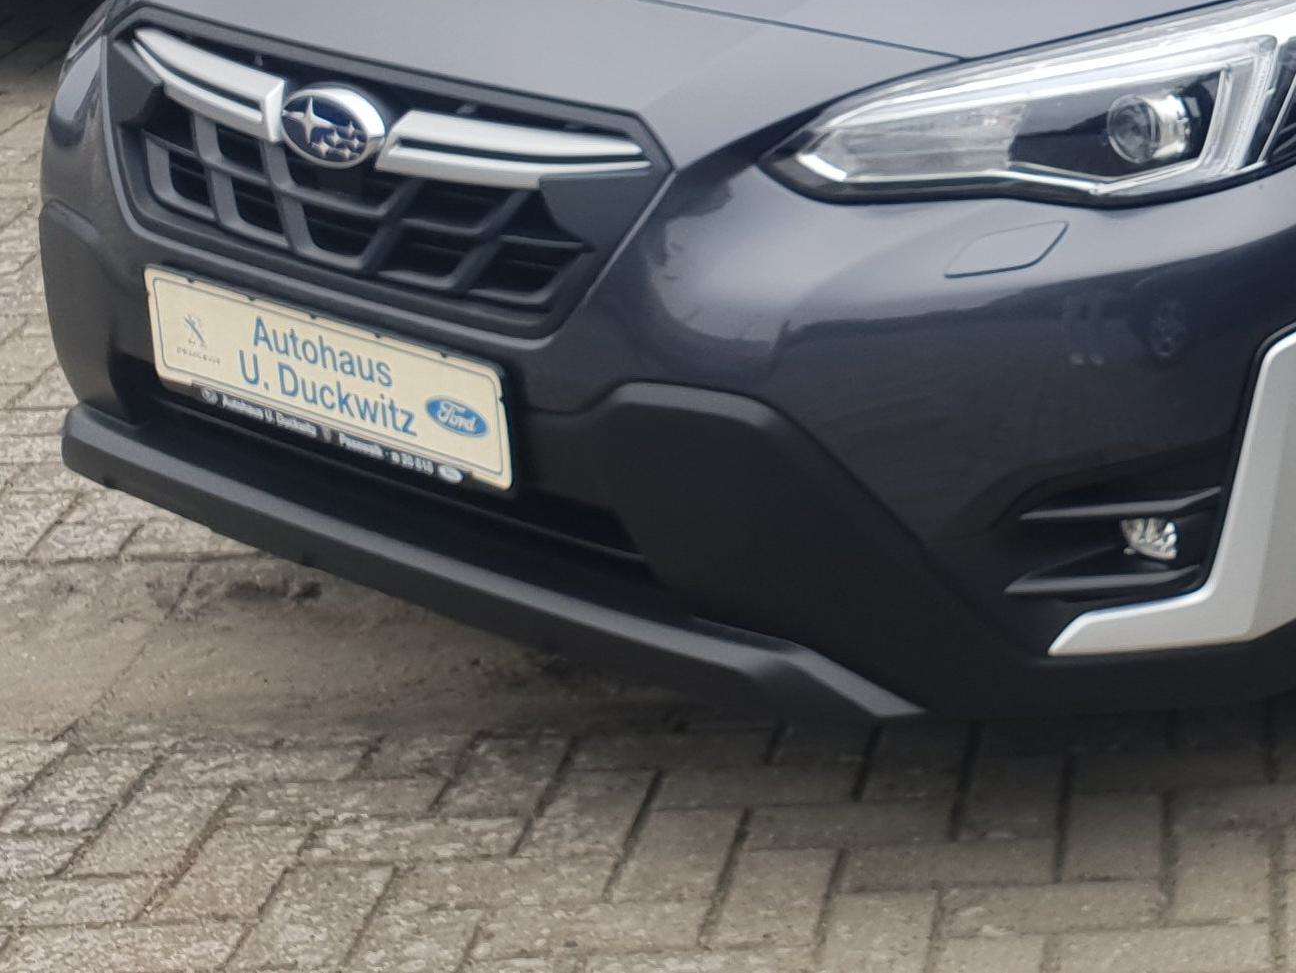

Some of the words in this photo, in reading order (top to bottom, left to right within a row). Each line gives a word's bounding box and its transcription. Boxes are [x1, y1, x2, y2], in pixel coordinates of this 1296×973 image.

[253, 316, 392, 387] Autohaus
[239, 350, 269, 390] U.
[277, 361, 417, 436] Duckwitz
[437, 400, 478, 432] Ford
